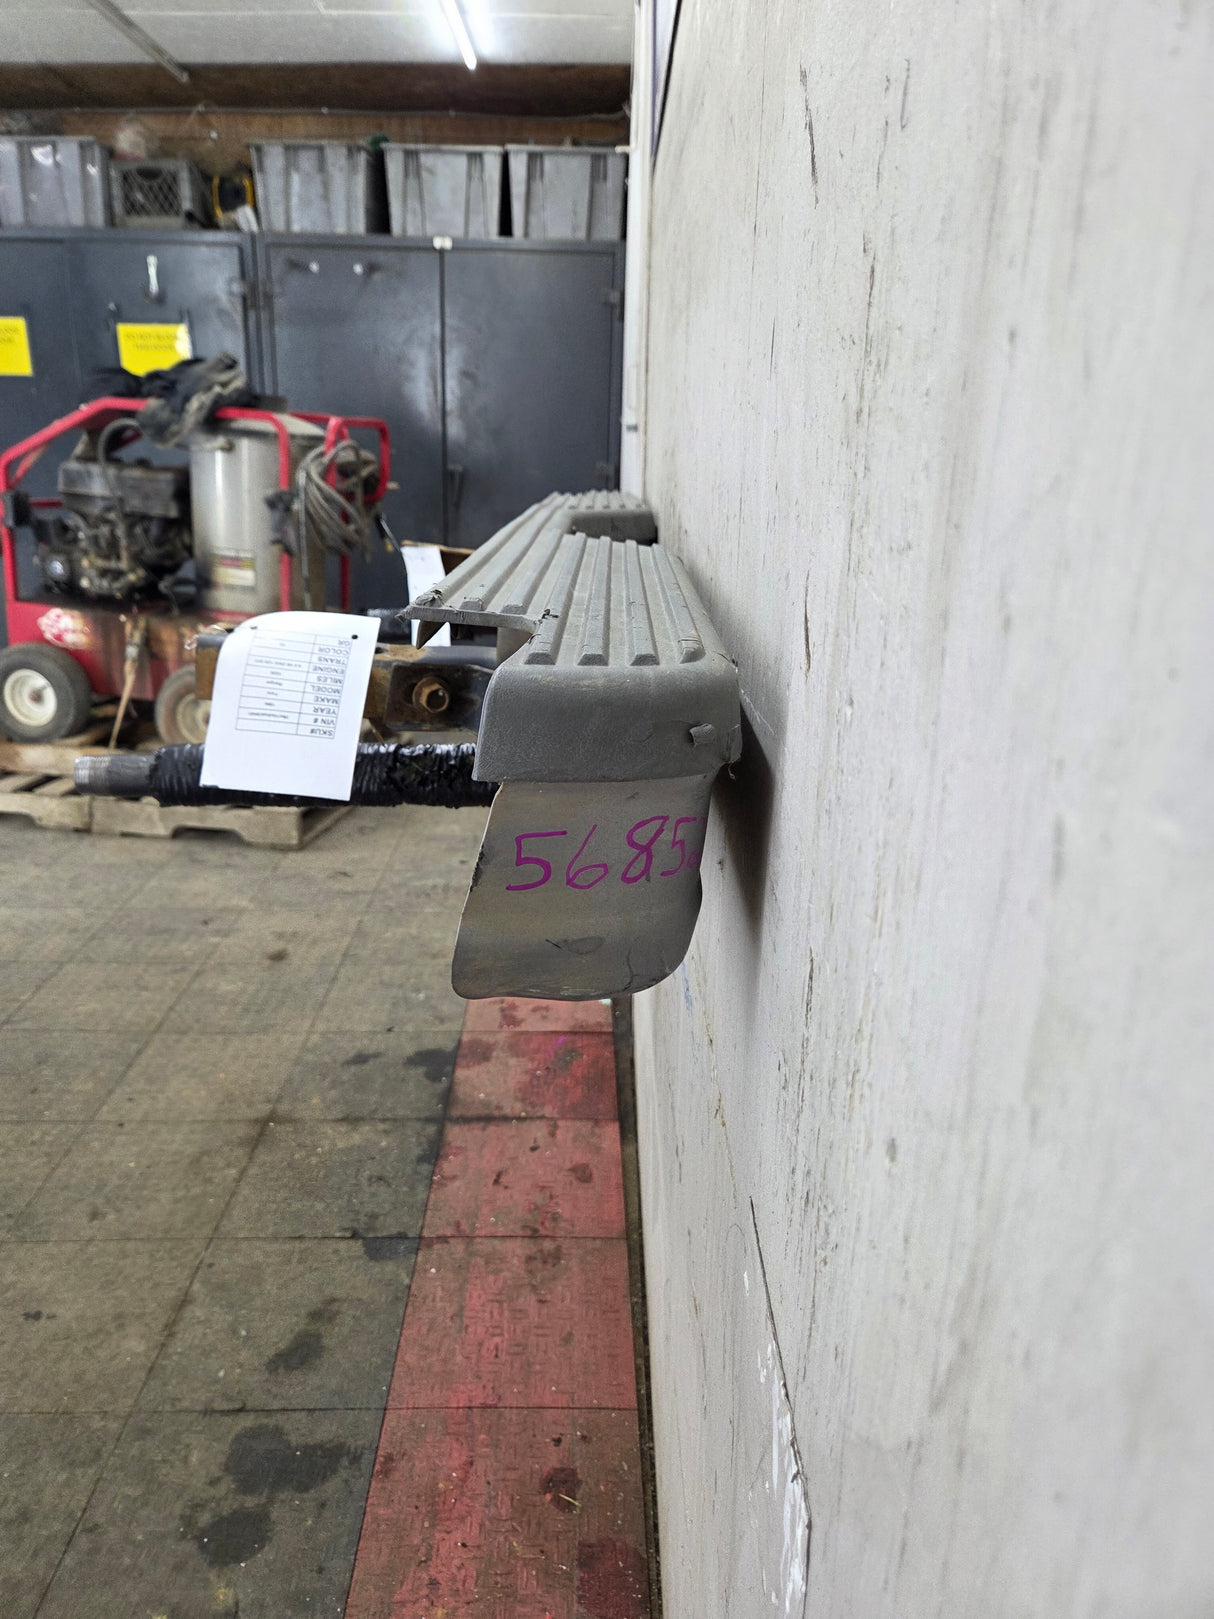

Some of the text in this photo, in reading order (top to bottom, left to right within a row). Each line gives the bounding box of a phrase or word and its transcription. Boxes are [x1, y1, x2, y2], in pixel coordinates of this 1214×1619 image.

[317, 656, 345, 665] TRANS
[313, 665, 345, 674] ENGINE
[317, 676, 343, 684] MILES
[311, 685, 340, 694] MODEL
[315, 696, 339, 705] MAKE
[313, 707, 337, 715] YEAR
[311, 728, 333, 736] SKU#
